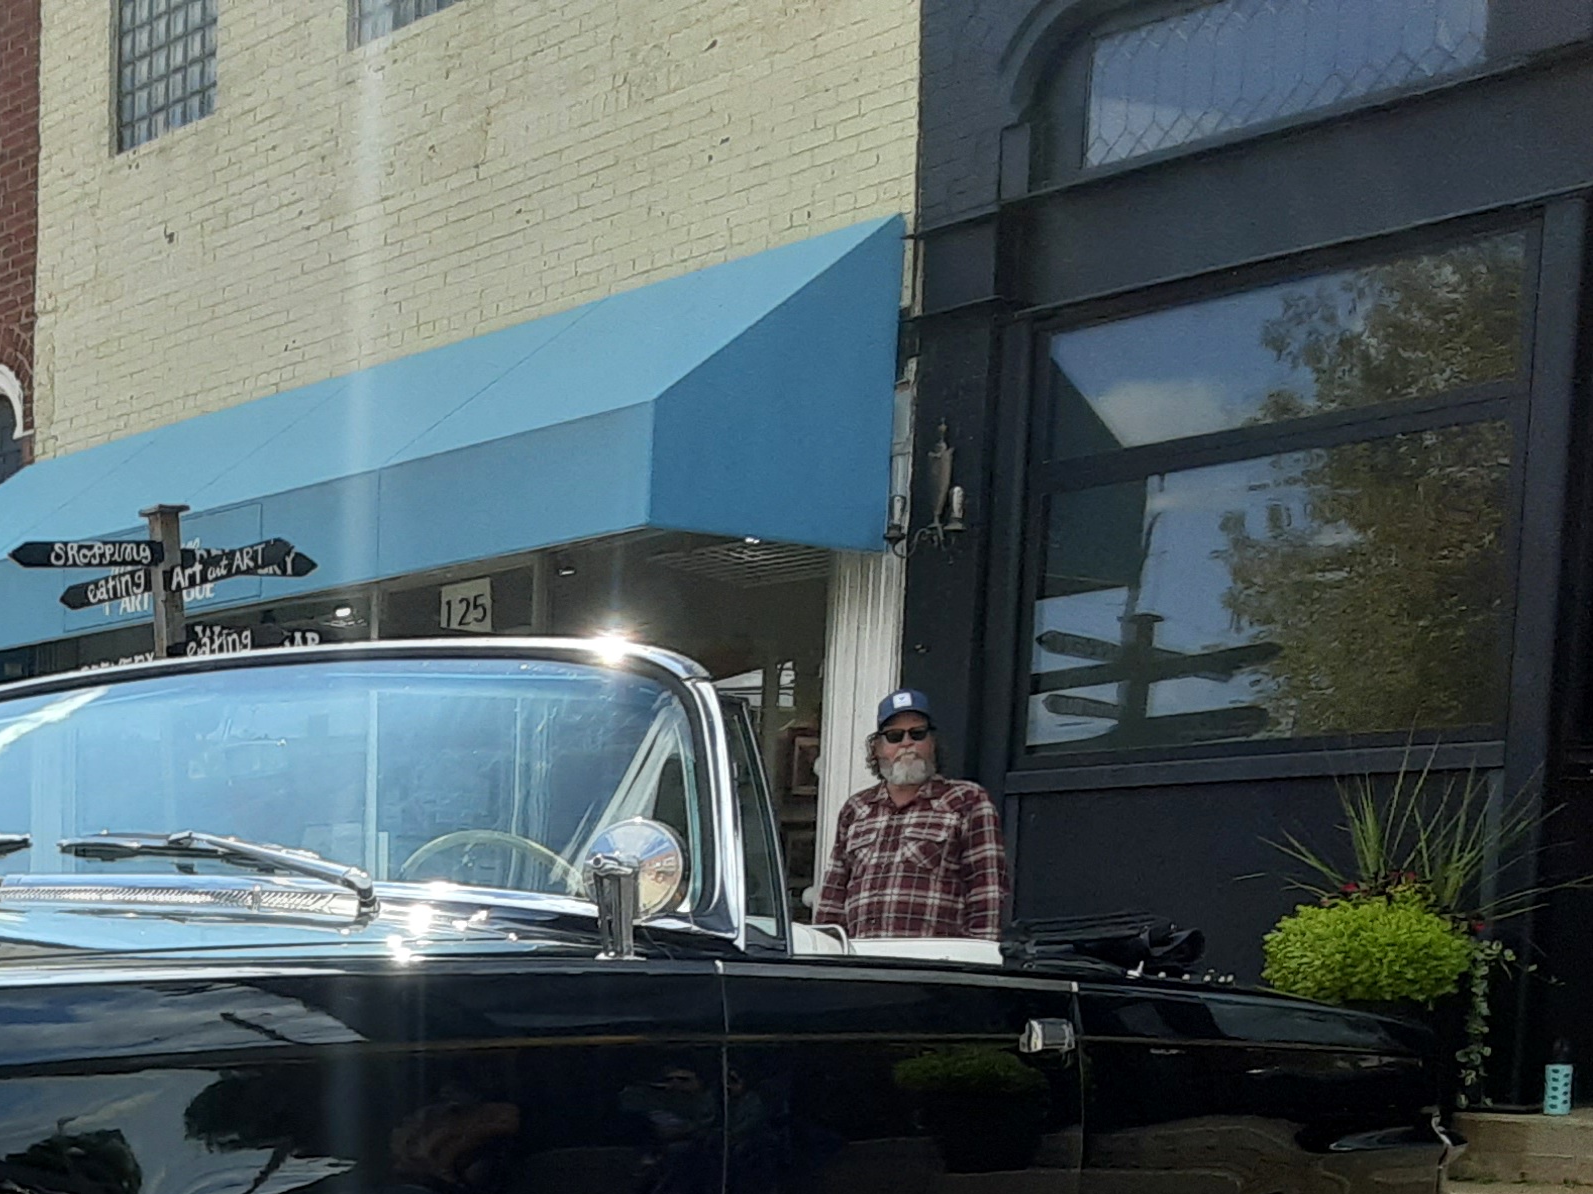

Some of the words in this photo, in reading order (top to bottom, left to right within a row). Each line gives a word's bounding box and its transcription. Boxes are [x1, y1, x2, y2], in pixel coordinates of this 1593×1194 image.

[86, 567, 145, 604] eating
[171, 562, 204, 591] Art
[232, 544, 266, 574] ART
[445, 593, 487, 628] 125
[186, 628, 252, 657] eating
